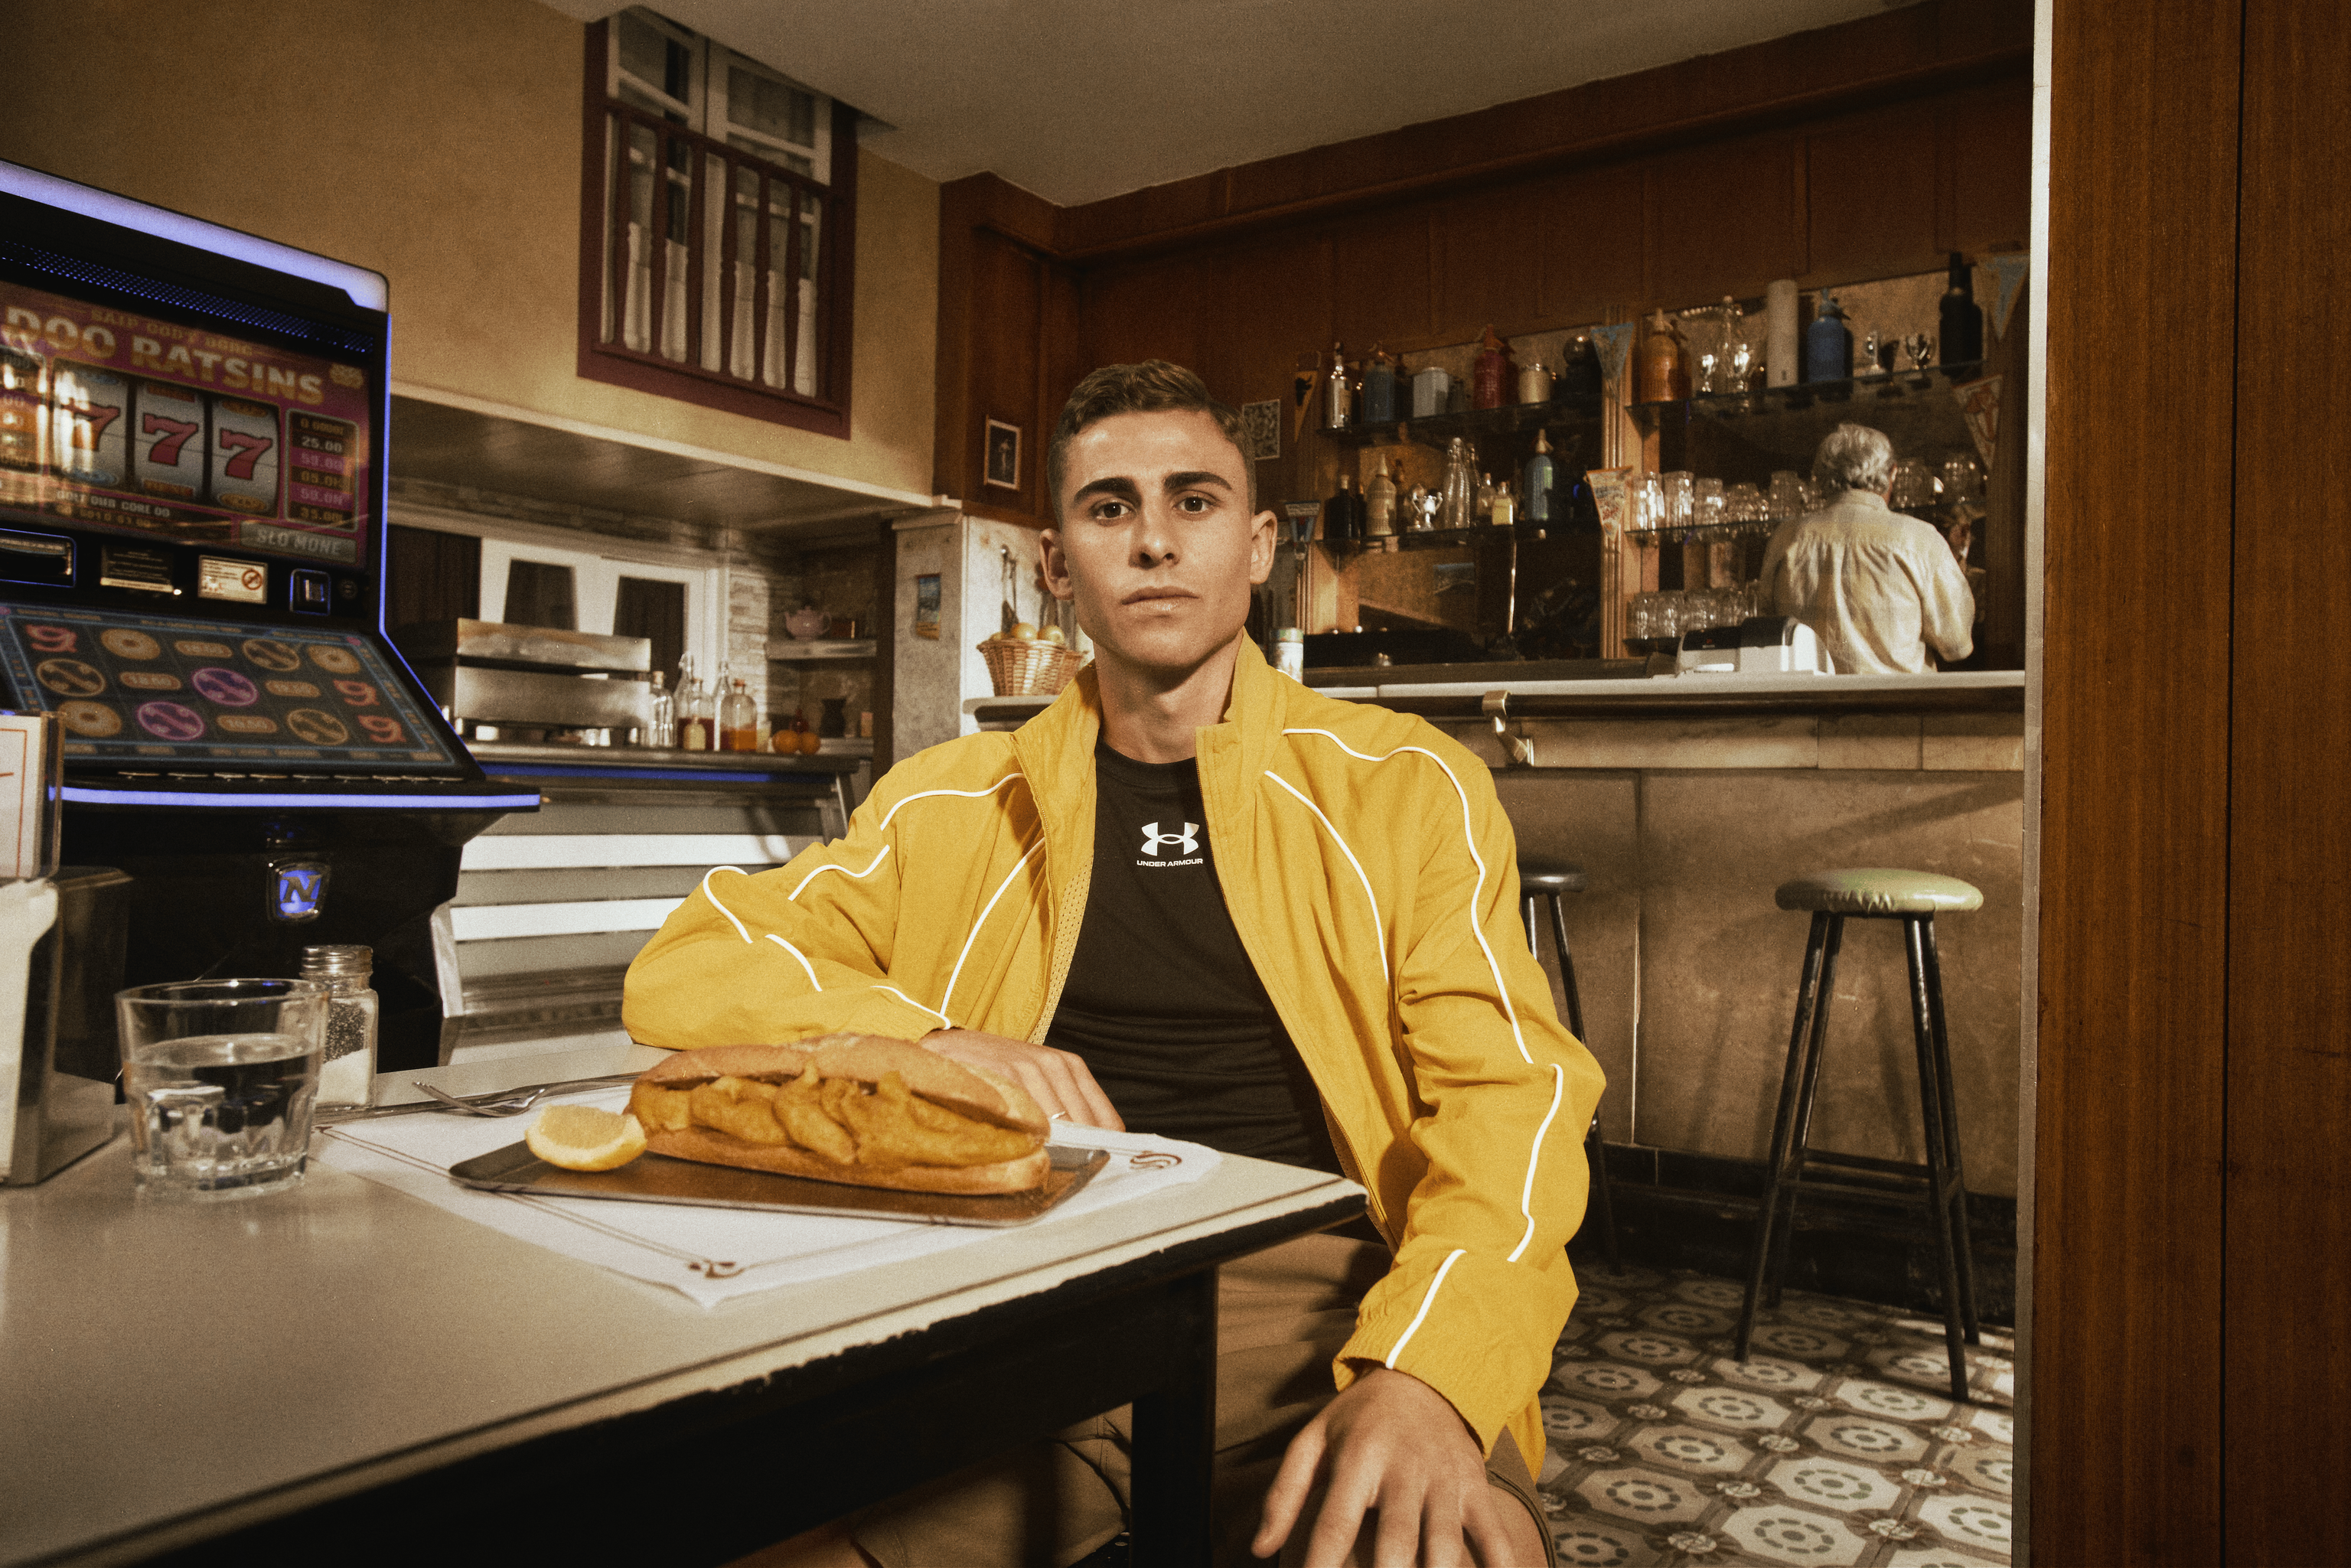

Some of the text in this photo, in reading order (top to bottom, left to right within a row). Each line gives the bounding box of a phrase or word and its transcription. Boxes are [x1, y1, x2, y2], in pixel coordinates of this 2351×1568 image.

[131, 334, 324, 406] RATSINS
[60, 395, 272, 481] 7 7 7
[1136, 858, 1204, 868] UNDER ARMOUR
[282, 875, 321, 904] N
